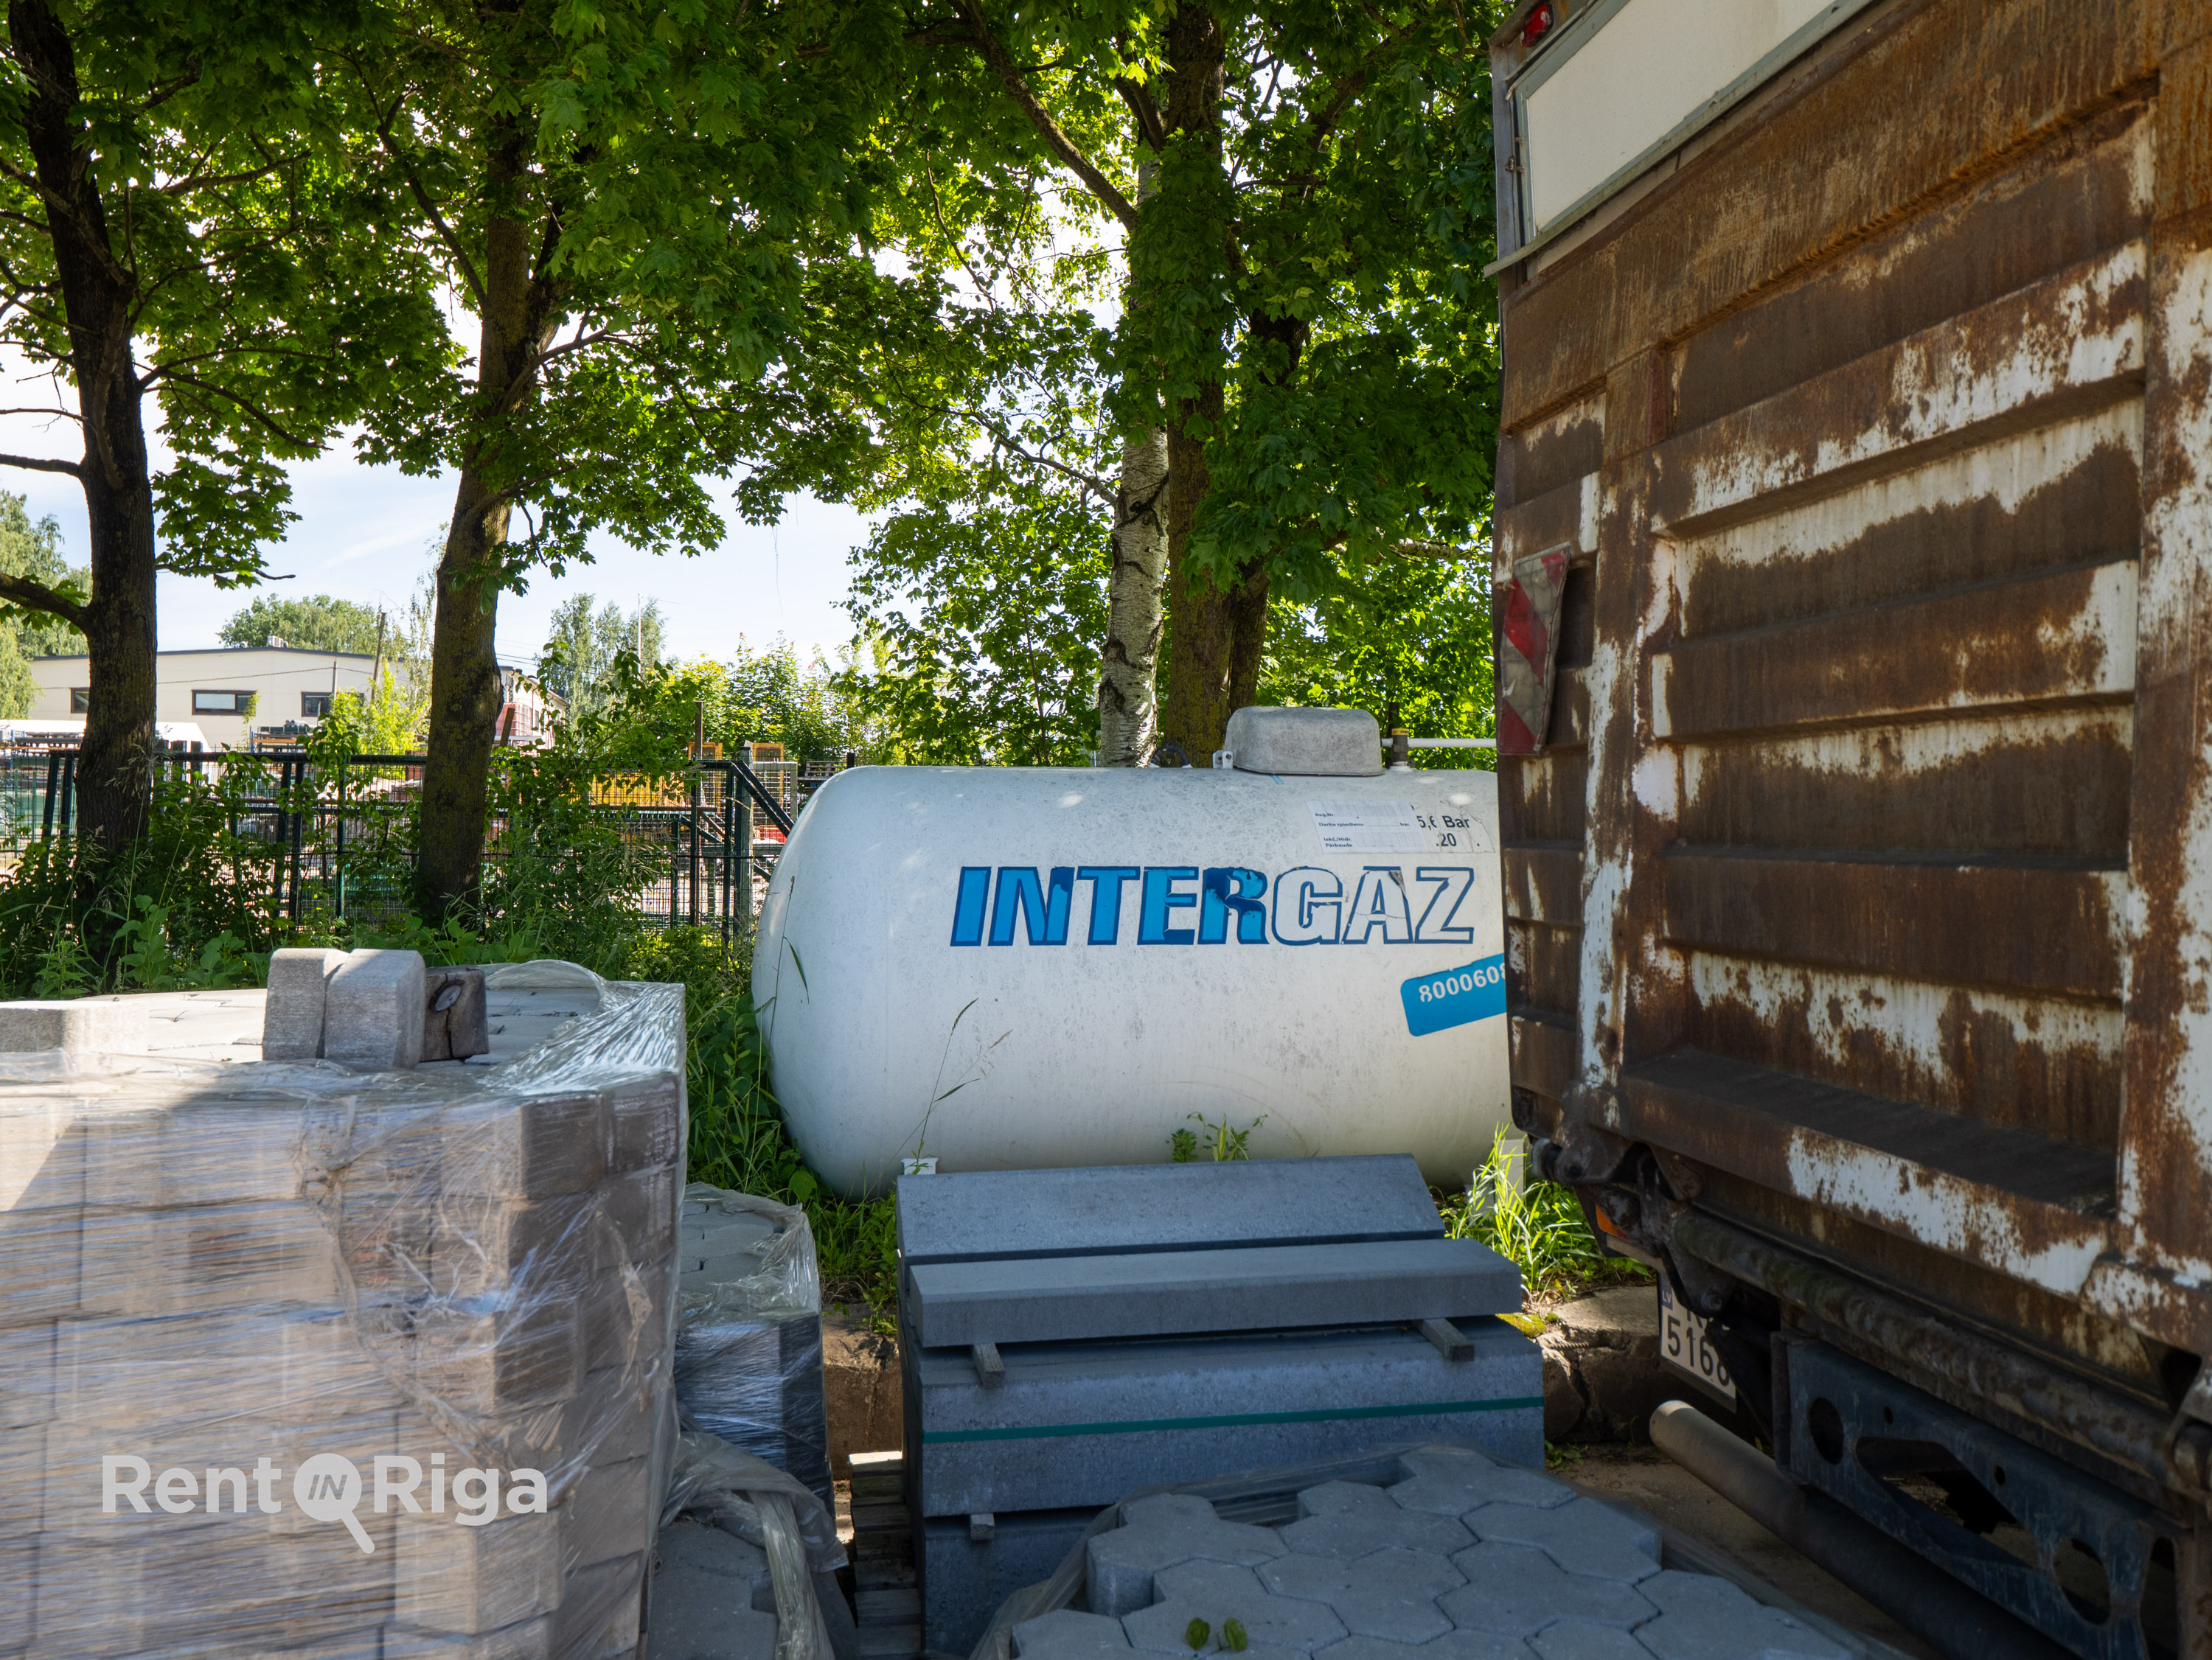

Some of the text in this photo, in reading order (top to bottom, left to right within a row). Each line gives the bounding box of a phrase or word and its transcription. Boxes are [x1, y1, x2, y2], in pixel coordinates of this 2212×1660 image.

[1441, 815, 1470, 828] Bar
[950, 865, 1475, 946] INTERGAZ
[1662, 1291, 1672, 1304] LV
